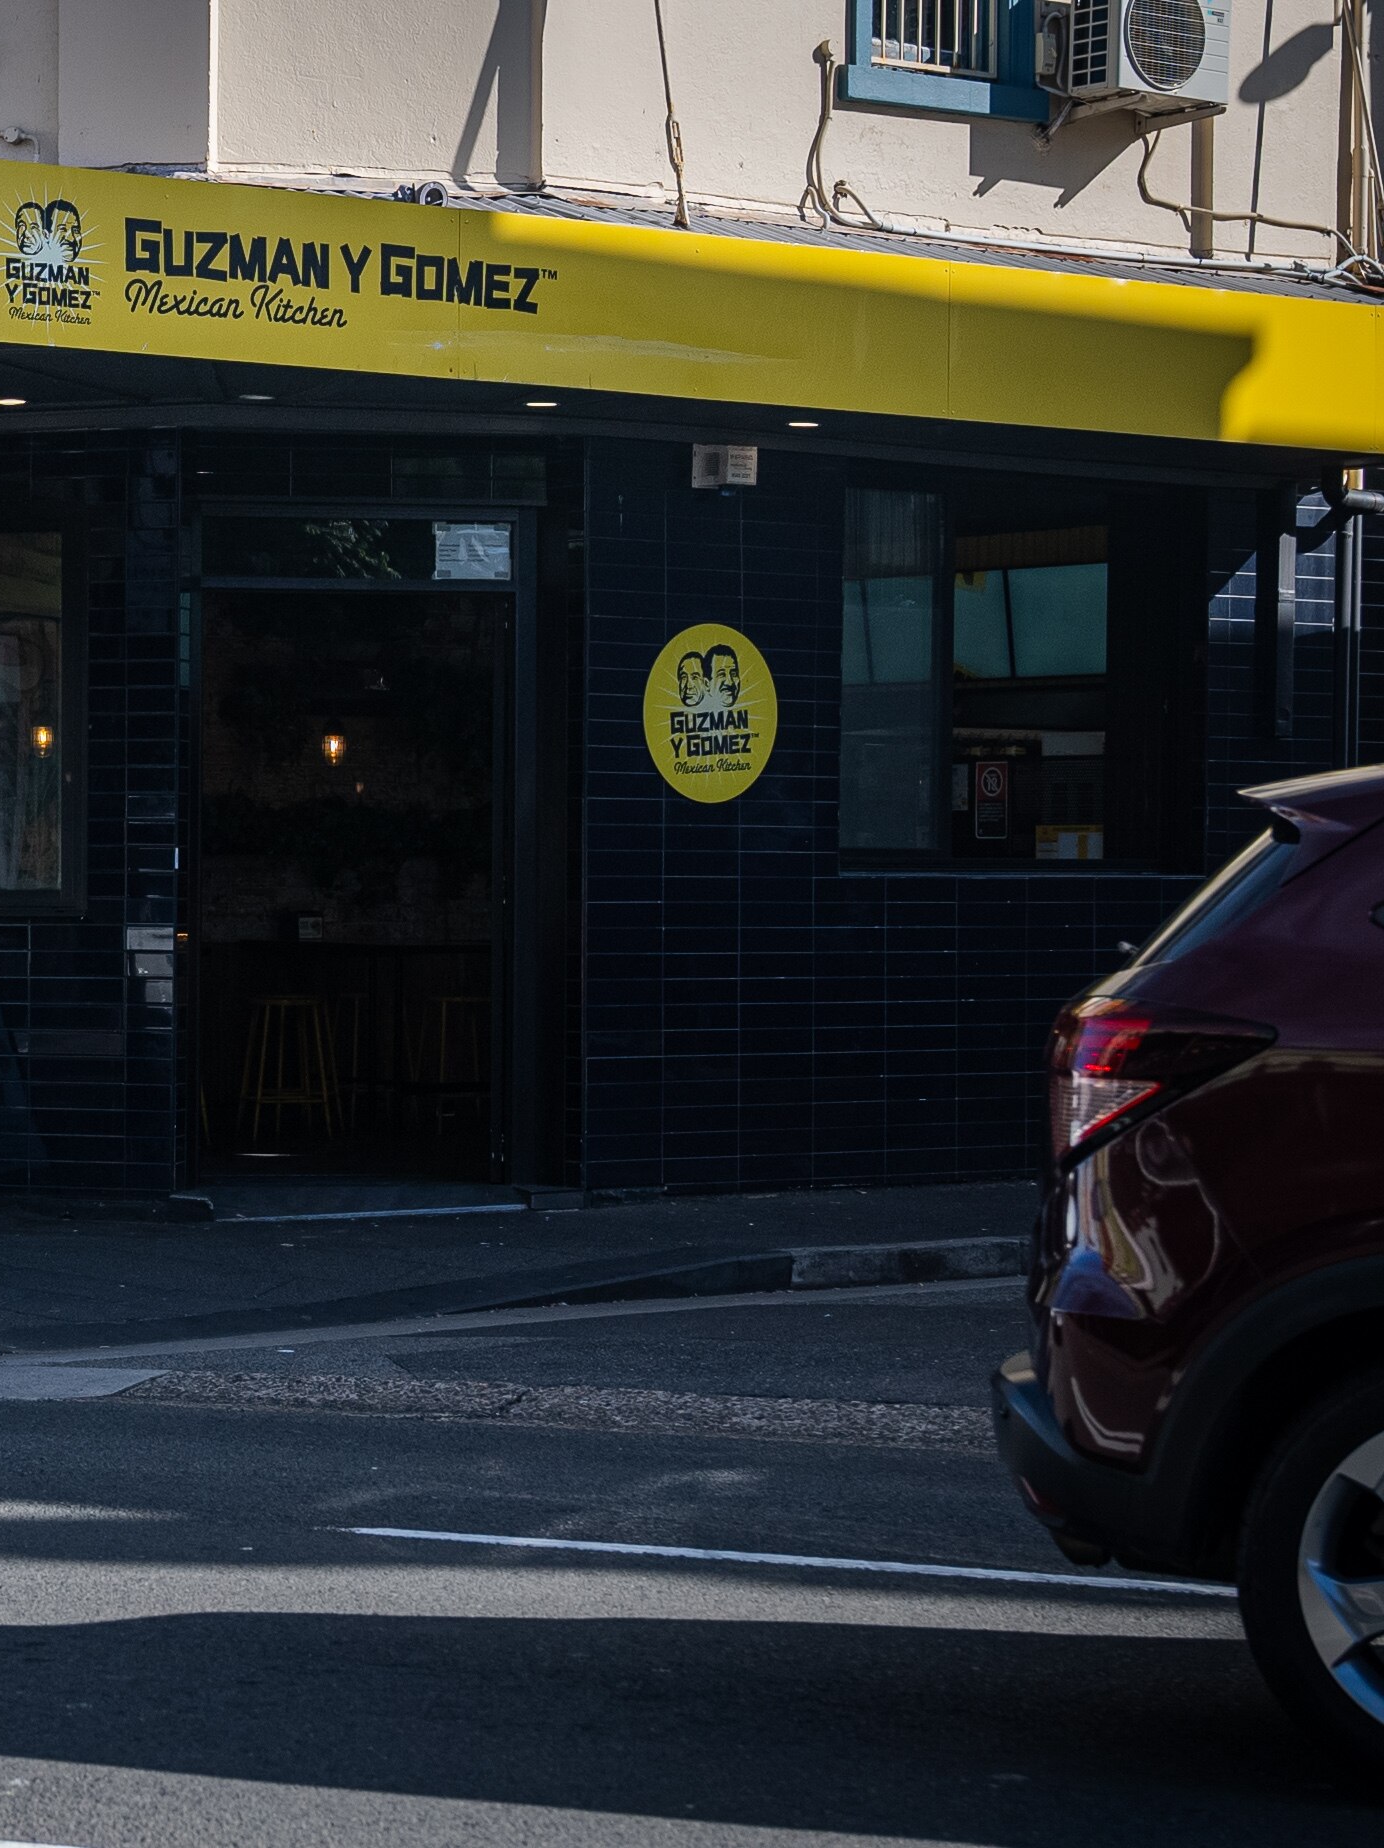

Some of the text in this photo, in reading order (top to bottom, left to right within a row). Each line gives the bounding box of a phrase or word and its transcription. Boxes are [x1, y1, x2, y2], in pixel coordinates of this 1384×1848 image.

[123, 216, 330, 288] GUZMAN
[340, 243, 373, 295] Y
[6, 258, 90, 286] GUZMAN
[5, 283, 19, 304] Y
[124, 279, 348, 329] Mexican Kitchen
[9, 306, 92, 325] Mexican Kitchen
[670, 710, 749, 734] GUZMAN
[670, 737, 683, 758] Y
[674, 758, 752, 775] Mexican Kitchen
